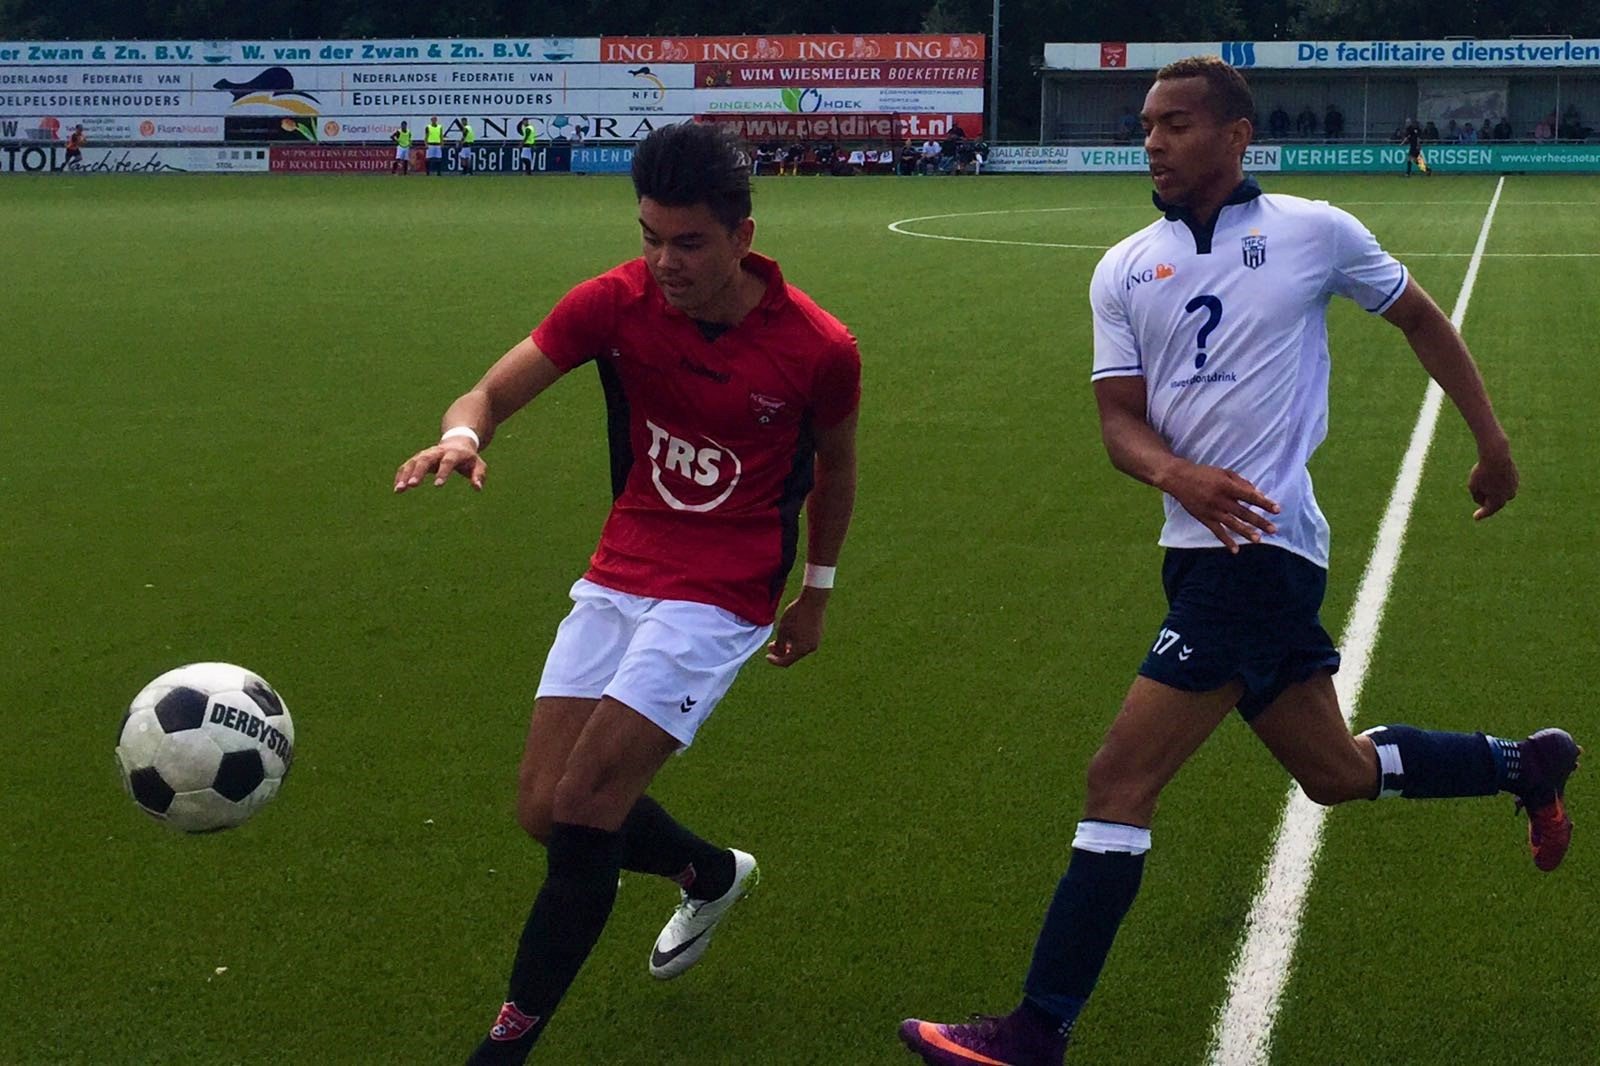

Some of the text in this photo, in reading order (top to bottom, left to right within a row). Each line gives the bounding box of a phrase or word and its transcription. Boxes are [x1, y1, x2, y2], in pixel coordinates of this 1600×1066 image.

[0, 45, 194, 60] er Zwan & Zn. B.V.
[242, 43, 532, 60] W. van der Zwan & Zn. B.V.
[607, 43, 654, 61] ING
[703, 43, 749, 61] ING
[798, 41, 845, 59] ING
[895, 41, 942, 58] ING
[1298, 43, 1328, 61] De
[1336, 42, 1445, 61] facilitaire
[0, 73, 181, 84] DERLANDSE FEDERATIE VAN
[353, 72, 553, 83] NEDERLANDSE FEDERATIE VAN
[740, 67, 979, 81] WIM WIESMEIJER BOEKETTERIE
[353, 92, 553, 105] EDELPELSDIERENHOUDERS
[709, 101, 862, 110] DINGEMAN HOEK
[342, 124, 401, 134] FloraHollan
[704, 114, 953, 138] ww.petdirect.nl
[0, 147, 63, 172] TOL
[512, 146, 546, 170] Bvd
[571, 149, 637, 163] FRIEND
[1081, 151, 1150, 165] VERHEE
[1286, 149, 1491, 164] VERHEES NORISSEN
[646, 420, 721, 486] TRS
[1152, 627, 1181, 655] 17
